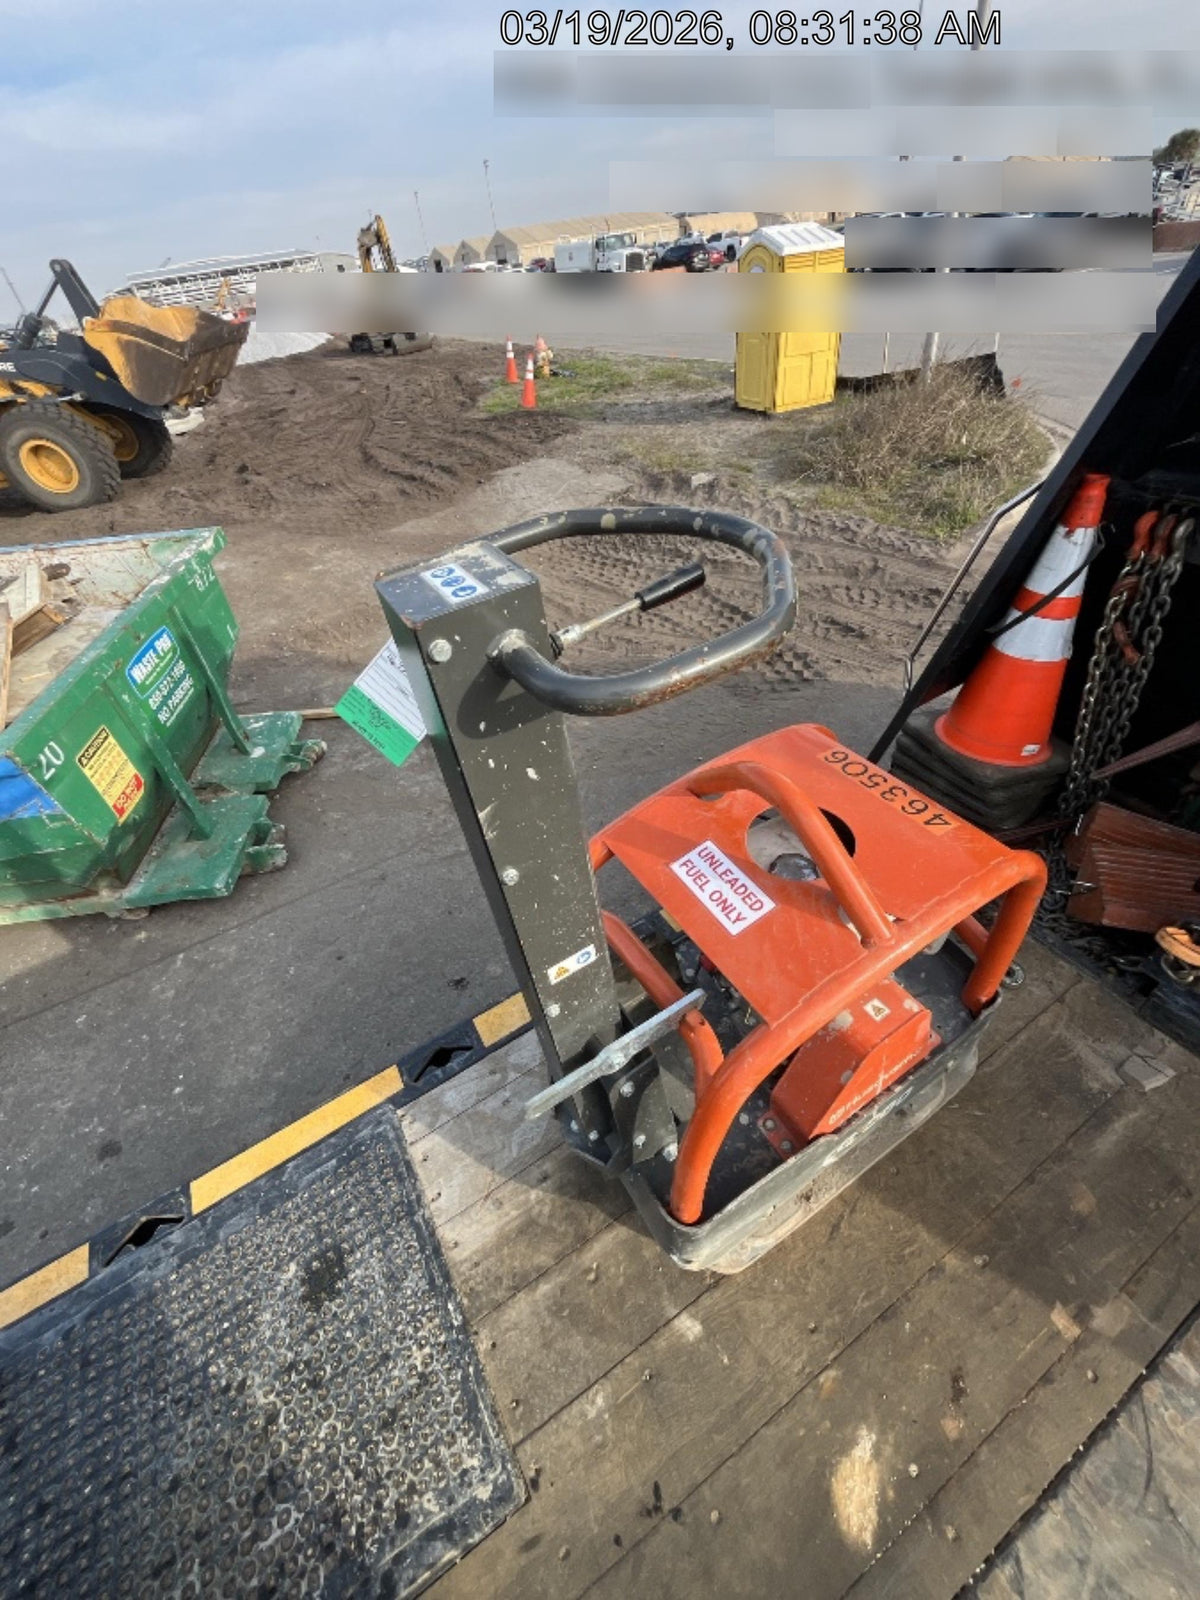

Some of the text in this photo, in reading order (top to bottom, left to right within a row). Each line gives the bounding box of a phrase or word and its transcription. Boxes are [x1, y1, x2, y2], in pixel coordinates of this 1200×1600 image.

[130, 646, 161, 684] WASTE
[157, 709, 170, 725] NO
[168, 673, 195, 712] PARKING
[39, 741, 65, 780] 20
[824, 749, 952, 828] 463506
[680, 858, 748, 926] FUEL ONLY
[697, 846, 765, 912] UNLEADED
